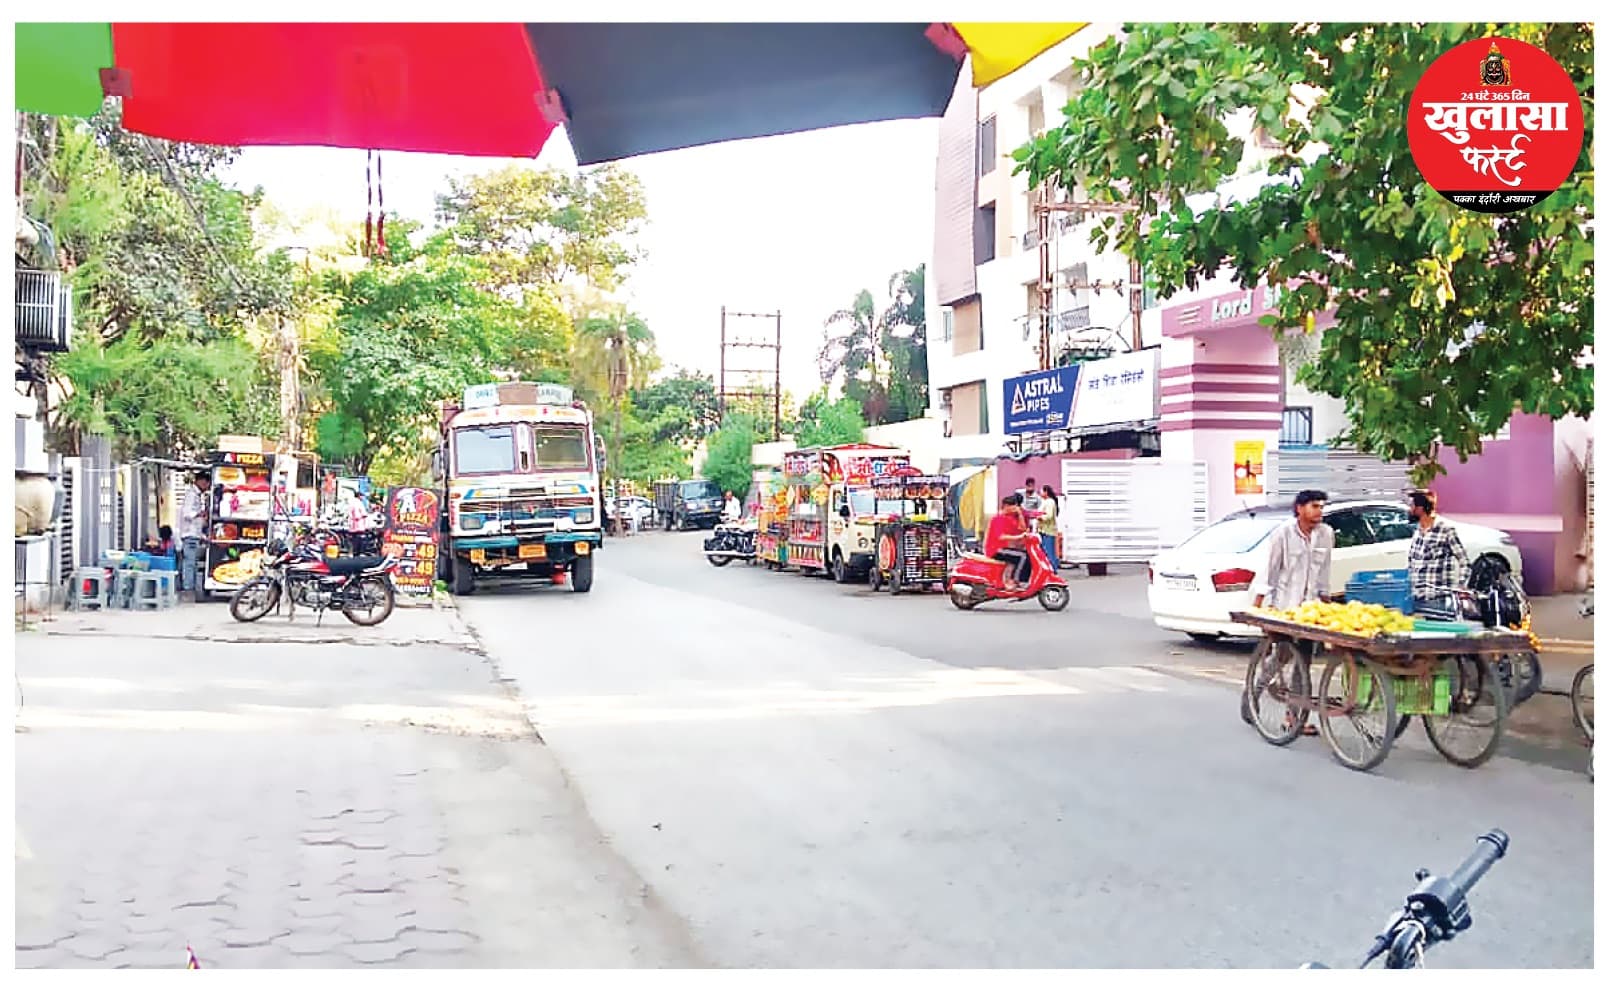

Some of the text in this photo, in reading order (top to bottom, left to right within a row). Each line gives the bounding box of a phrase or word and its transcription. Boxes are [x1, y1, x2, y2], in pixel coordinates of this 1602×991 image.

[1211, 289, 1254, 323] Lord
[1025, 374, 1064, 398] ASTRAL
[1026, 398, 1050, 412] PIPES
[236, 453, 264, 465] PIZZA
[399, 511, 428, 524] PIZZA
[418, 544, 435, 558] 49
[417, 561, 433, 576] 49
